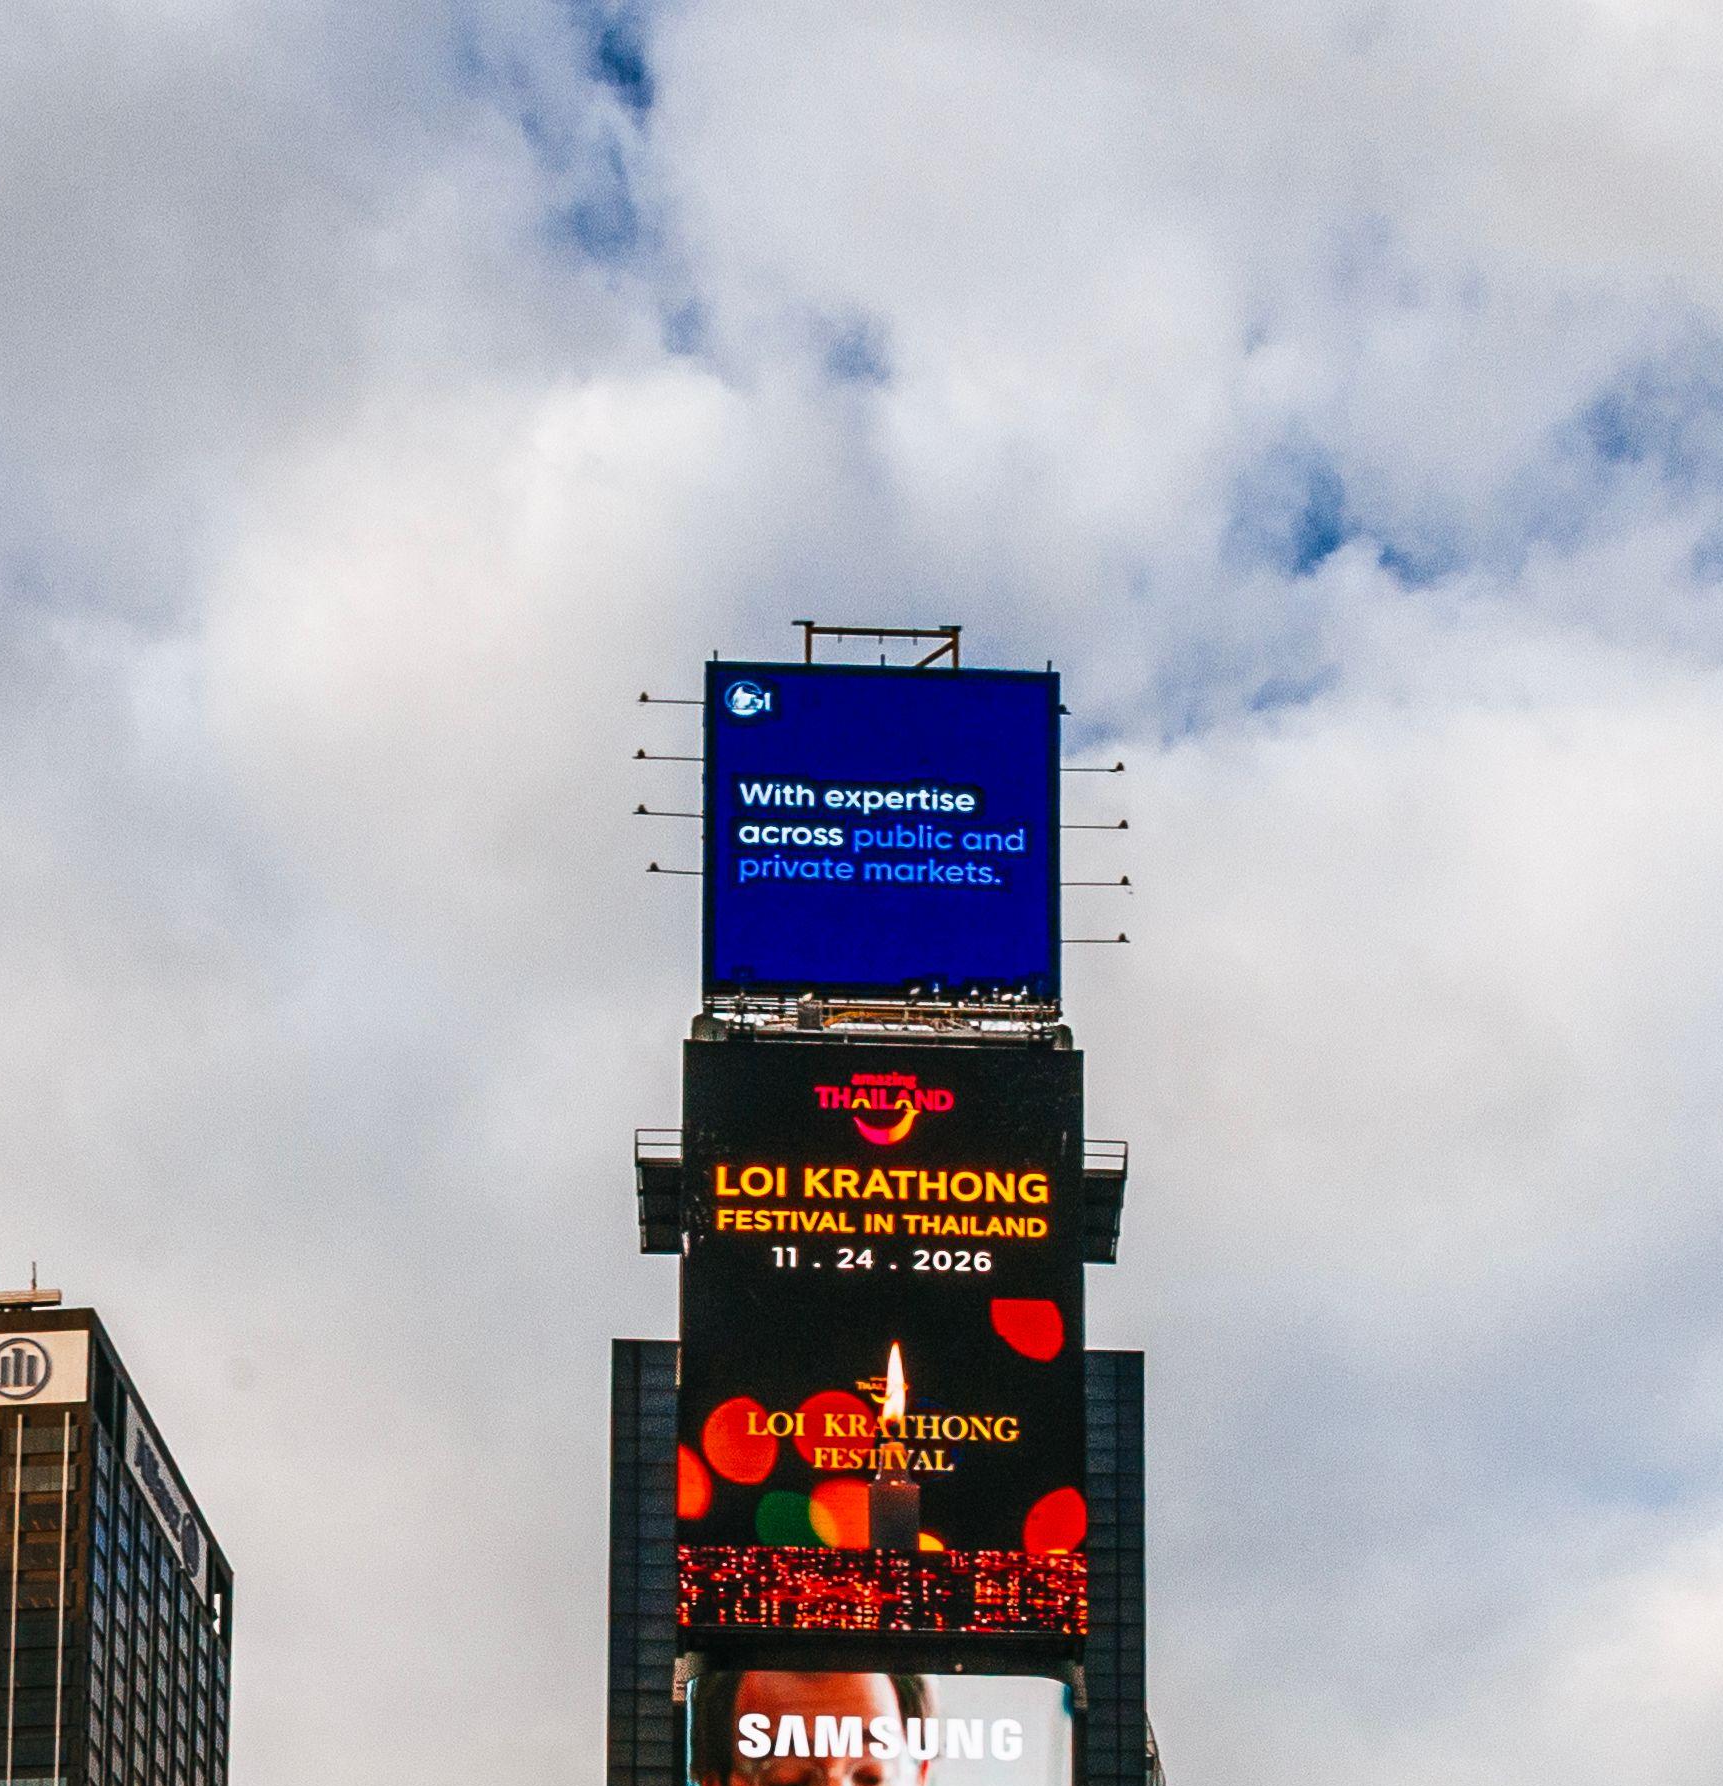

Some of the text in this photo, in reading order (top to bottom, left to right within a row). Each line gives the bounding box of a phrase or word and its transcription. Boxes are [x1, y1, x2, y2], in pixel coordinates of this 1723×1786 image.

[739, 782, 975, 814] With expertise
[738, 822, 1025, 854] across public and
[738, 854, 1002, 885] private markets.
[851, 1072, 918, 1089] amazing
[814, 1085, 955, 1111] THAILAND
[715, 1165, 1050, 1205] LOI KRATHONG
[717, 1209, 1048, 1239] FESTIVAL IN THAILAND
[771, 1246, 992, 1272] 11 24 2026
[747, 1411, 1020, 1442] LOI KRATHONG
[813, 1447, 954, 1471] FESTIVAL
[738, 1713, 1023, 1761] SAMSUNG
